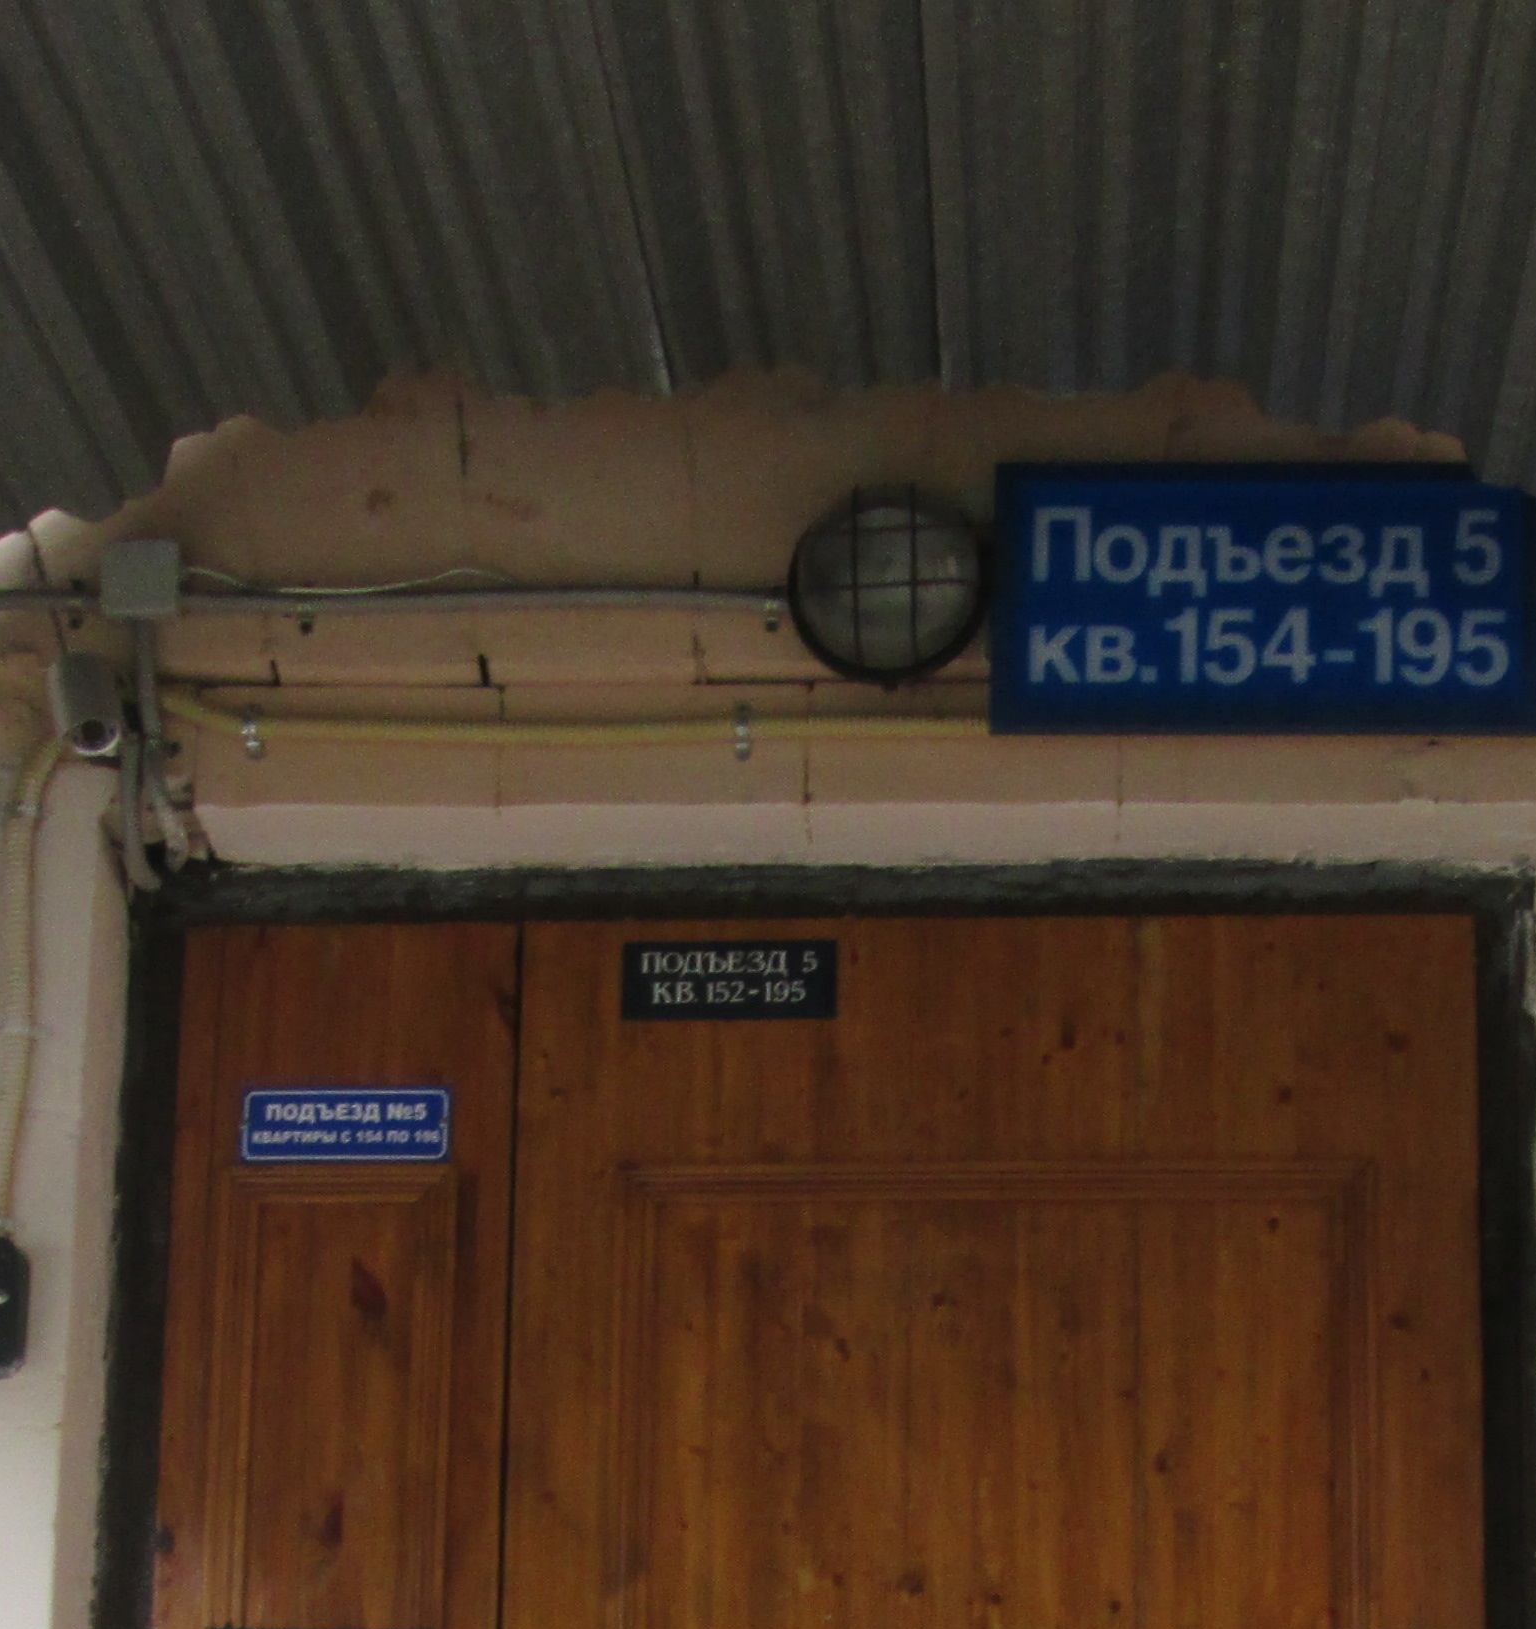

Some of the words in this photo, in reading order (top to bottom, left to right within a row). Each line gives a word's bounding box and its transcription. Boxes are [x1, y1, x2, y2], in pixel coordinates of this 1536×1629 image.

[1031, 507, 1430, 598] Подъезд
[1453, 509, 1502, 586] 5
[1027, 606, 1510, 687] кв.154-195
[640, 950, 789, 976] ПОДЪЕЗД
[802, 950, 818, 973] 5
[705, 979, 807, 1003] 152-195
[265, 1102, 381, 1124] ПОДЪЕЗД
[386, 1102, 428, 1121] №5
[251, 1130, 338, 1144] КВАРТИРЫ
[340, 1130, 352, 1144] С
[386, 1130, 410, 1144] ПО
